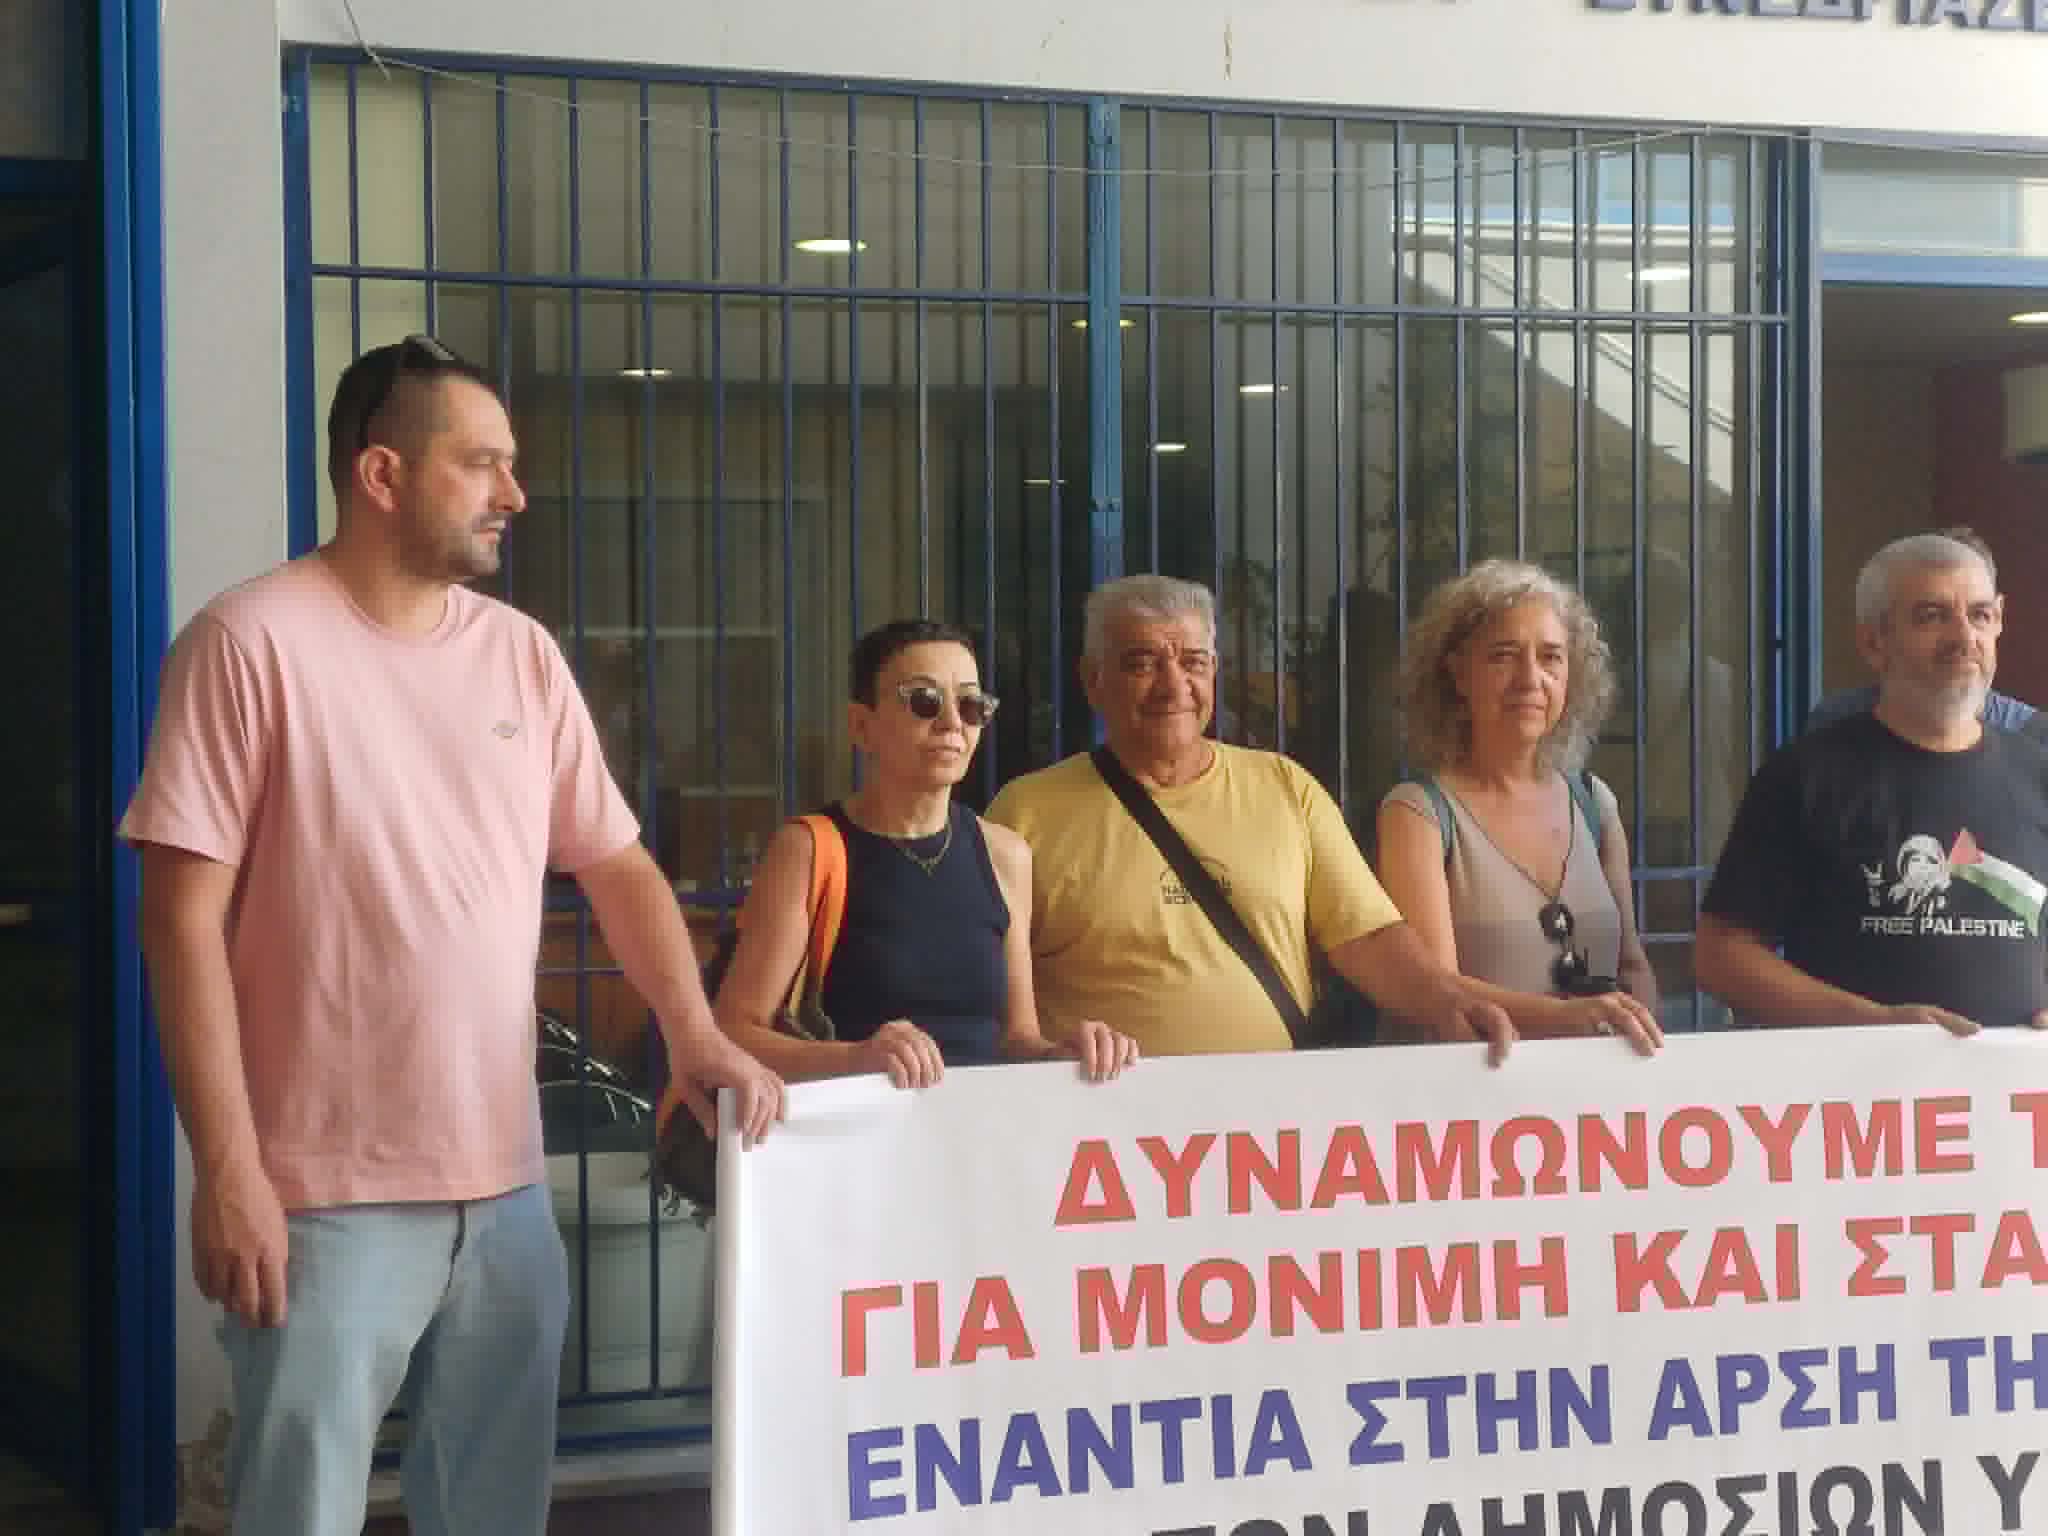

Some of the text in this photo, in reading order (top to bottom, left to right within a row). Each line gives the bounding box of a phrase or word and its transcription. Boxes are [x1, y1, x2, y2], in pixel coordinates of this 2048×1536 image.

[1861, 916, 2026, 938] FREE PALESTINE
[1055, 1096, 1974, 1225] ΔΥΝΑΜΩΝΟΥΜΕ
[841, 1211, 2048, 1377] ΓΙΑ ΜΟΝΙΜΗ ΚΑΙ ΣΤΑ
[847, 1334, 2048, 1521] ΕΝΑΝΤΙΑ ΣΤΗΝ ΑΡΣΗ ΤΗ
[1975, 1452, 2041, 1531] Υ
